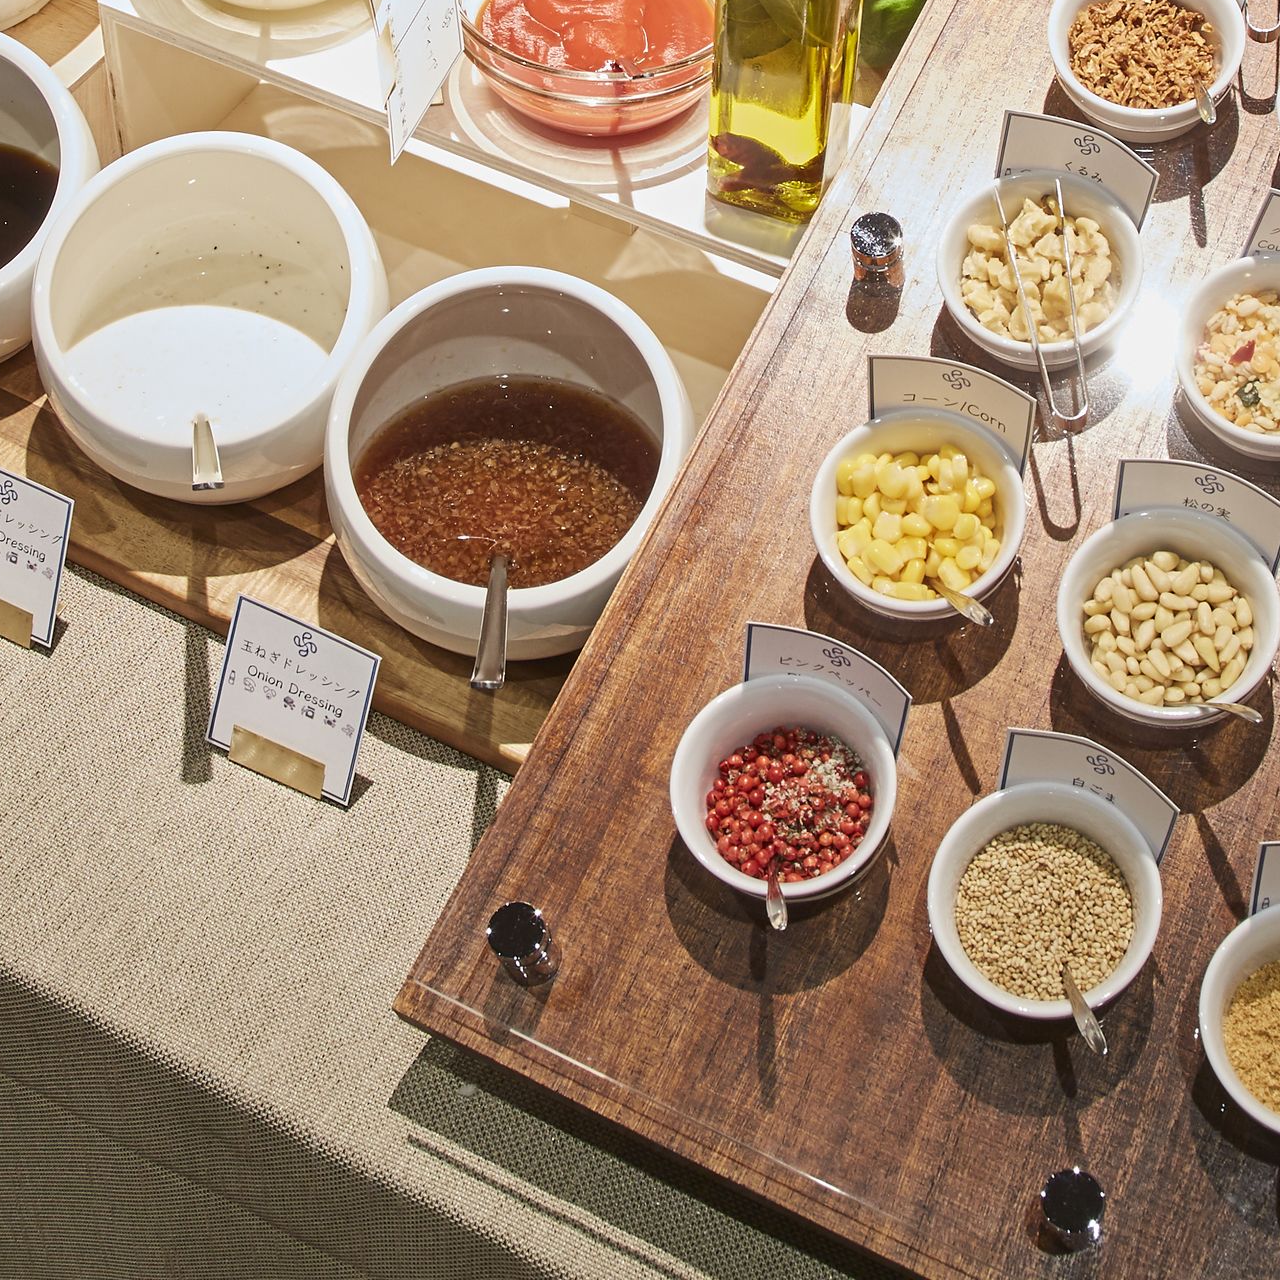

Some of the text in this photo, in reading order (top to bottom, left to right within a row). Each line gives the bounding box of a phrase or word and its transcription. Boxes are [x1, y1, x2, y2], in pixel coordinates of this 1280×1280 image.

[1065, 161, 1104, 184] くるみ
[903, 393, 1006, 433] コーン/Corn
[1182, 497, 1233, 521] 松の実
[240, 639, 361, 700] 玉ねぎドレッシング
[247, 664, 344, 718] Onion Dressing
[780, 655, 883, 707] ピンクペッパー
